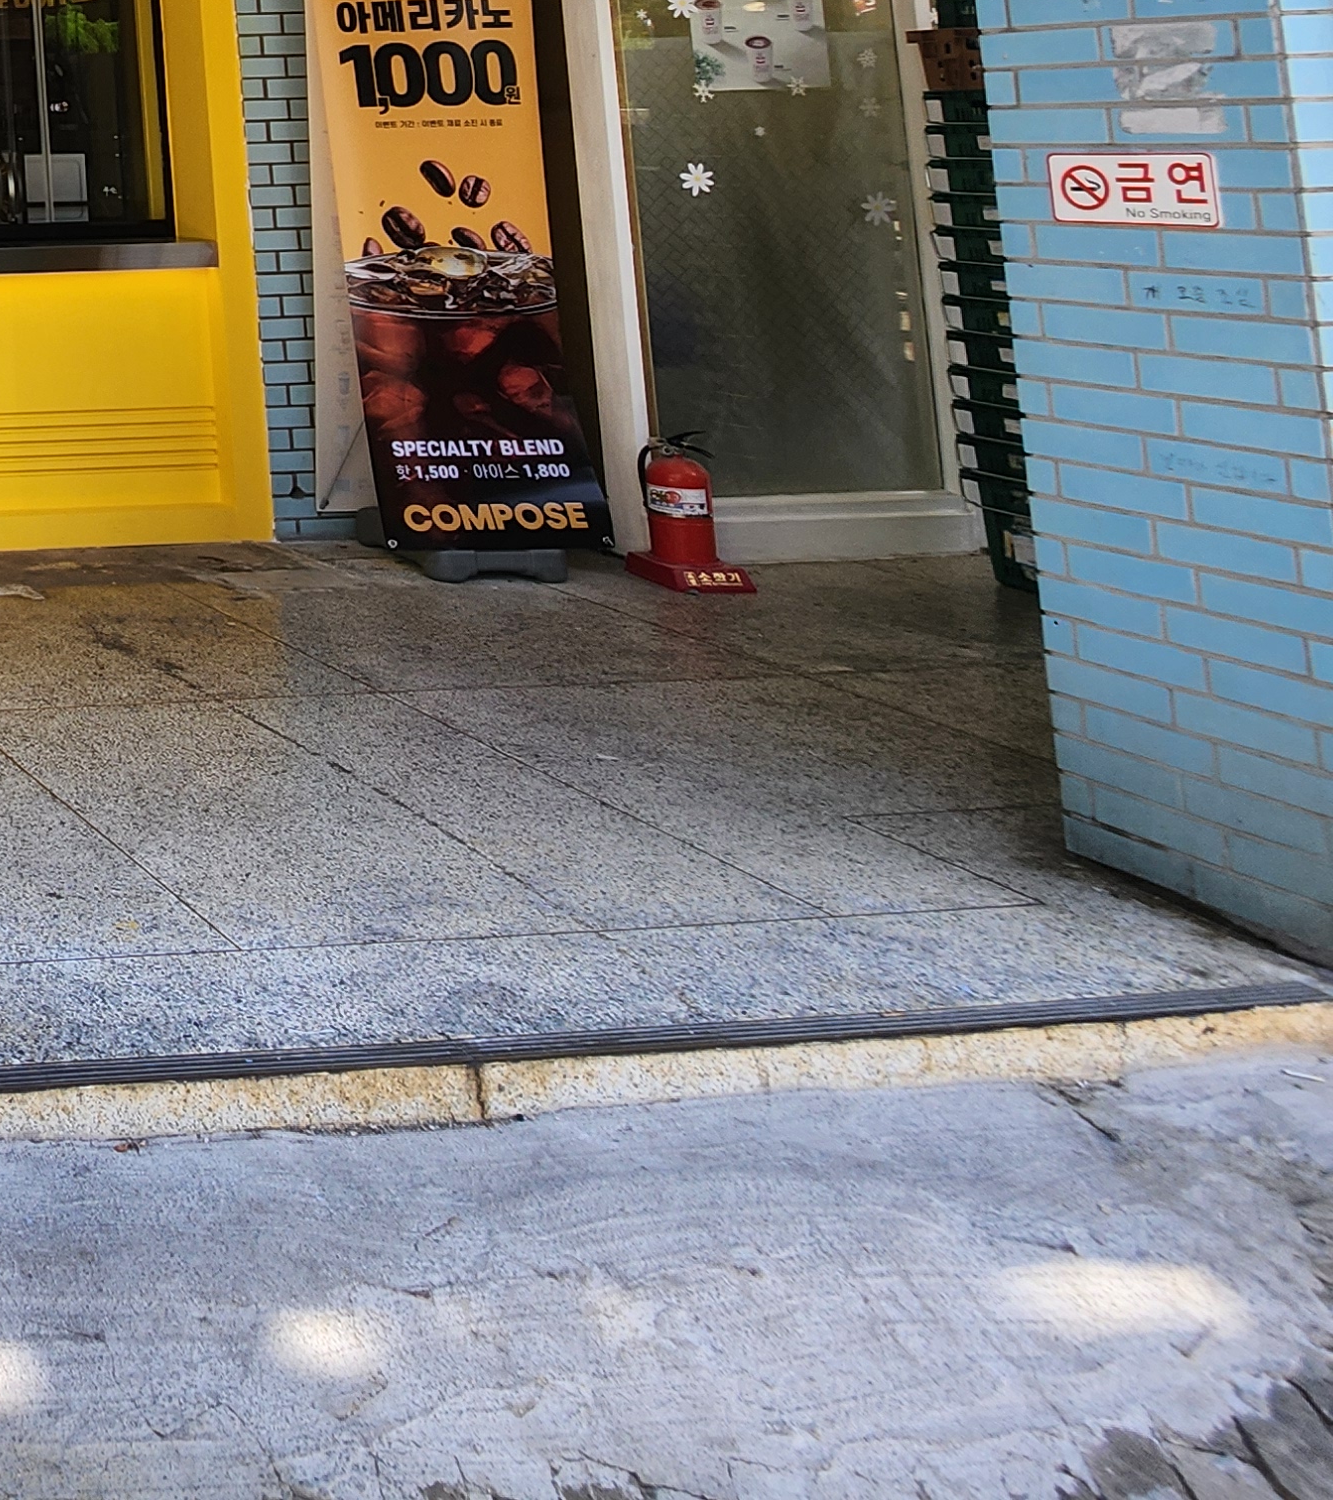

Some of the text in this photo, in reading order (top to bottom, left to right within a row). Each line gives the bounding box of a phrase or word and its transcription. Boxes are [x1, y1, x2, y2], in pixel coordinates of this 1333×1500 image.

[1126, 207, 1211, 222] No Smoking
[391, 439, 565, 457] SPECIALTY BLEND
[414, 465, 459, 482] 1,500
[473, 463, 520, 479] 아이스
[522, 463, 570, 481] 1,800
[403, 502, 589, 532] COMPOSE
